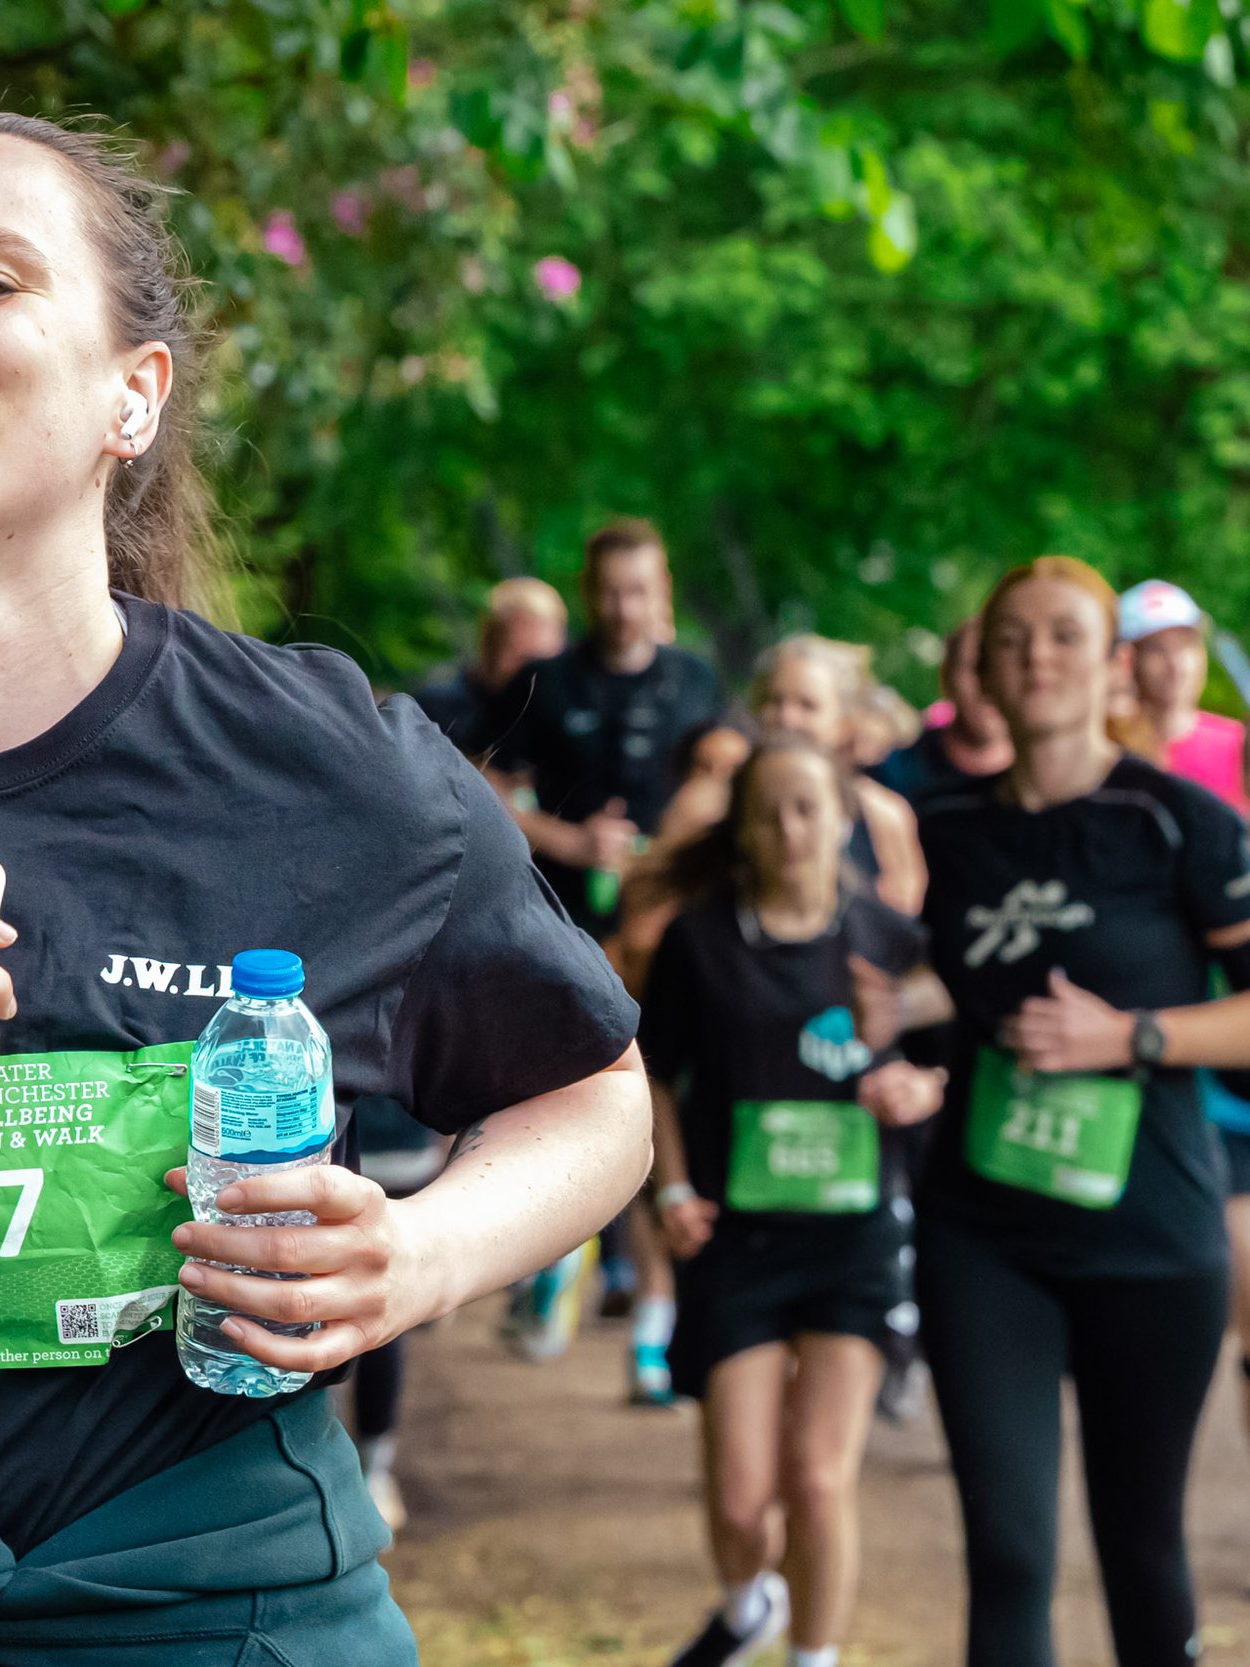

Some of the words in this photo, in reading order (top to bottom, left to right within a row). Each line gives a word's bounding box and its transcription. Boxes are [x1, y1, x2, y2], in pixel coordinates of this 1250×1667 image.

[9, 1131, 26, 1149] &
[33, 1125, 105, 1148] WALK
[32, 1350, 81, 1368] person
[84, 1350, 103, 1360] on
